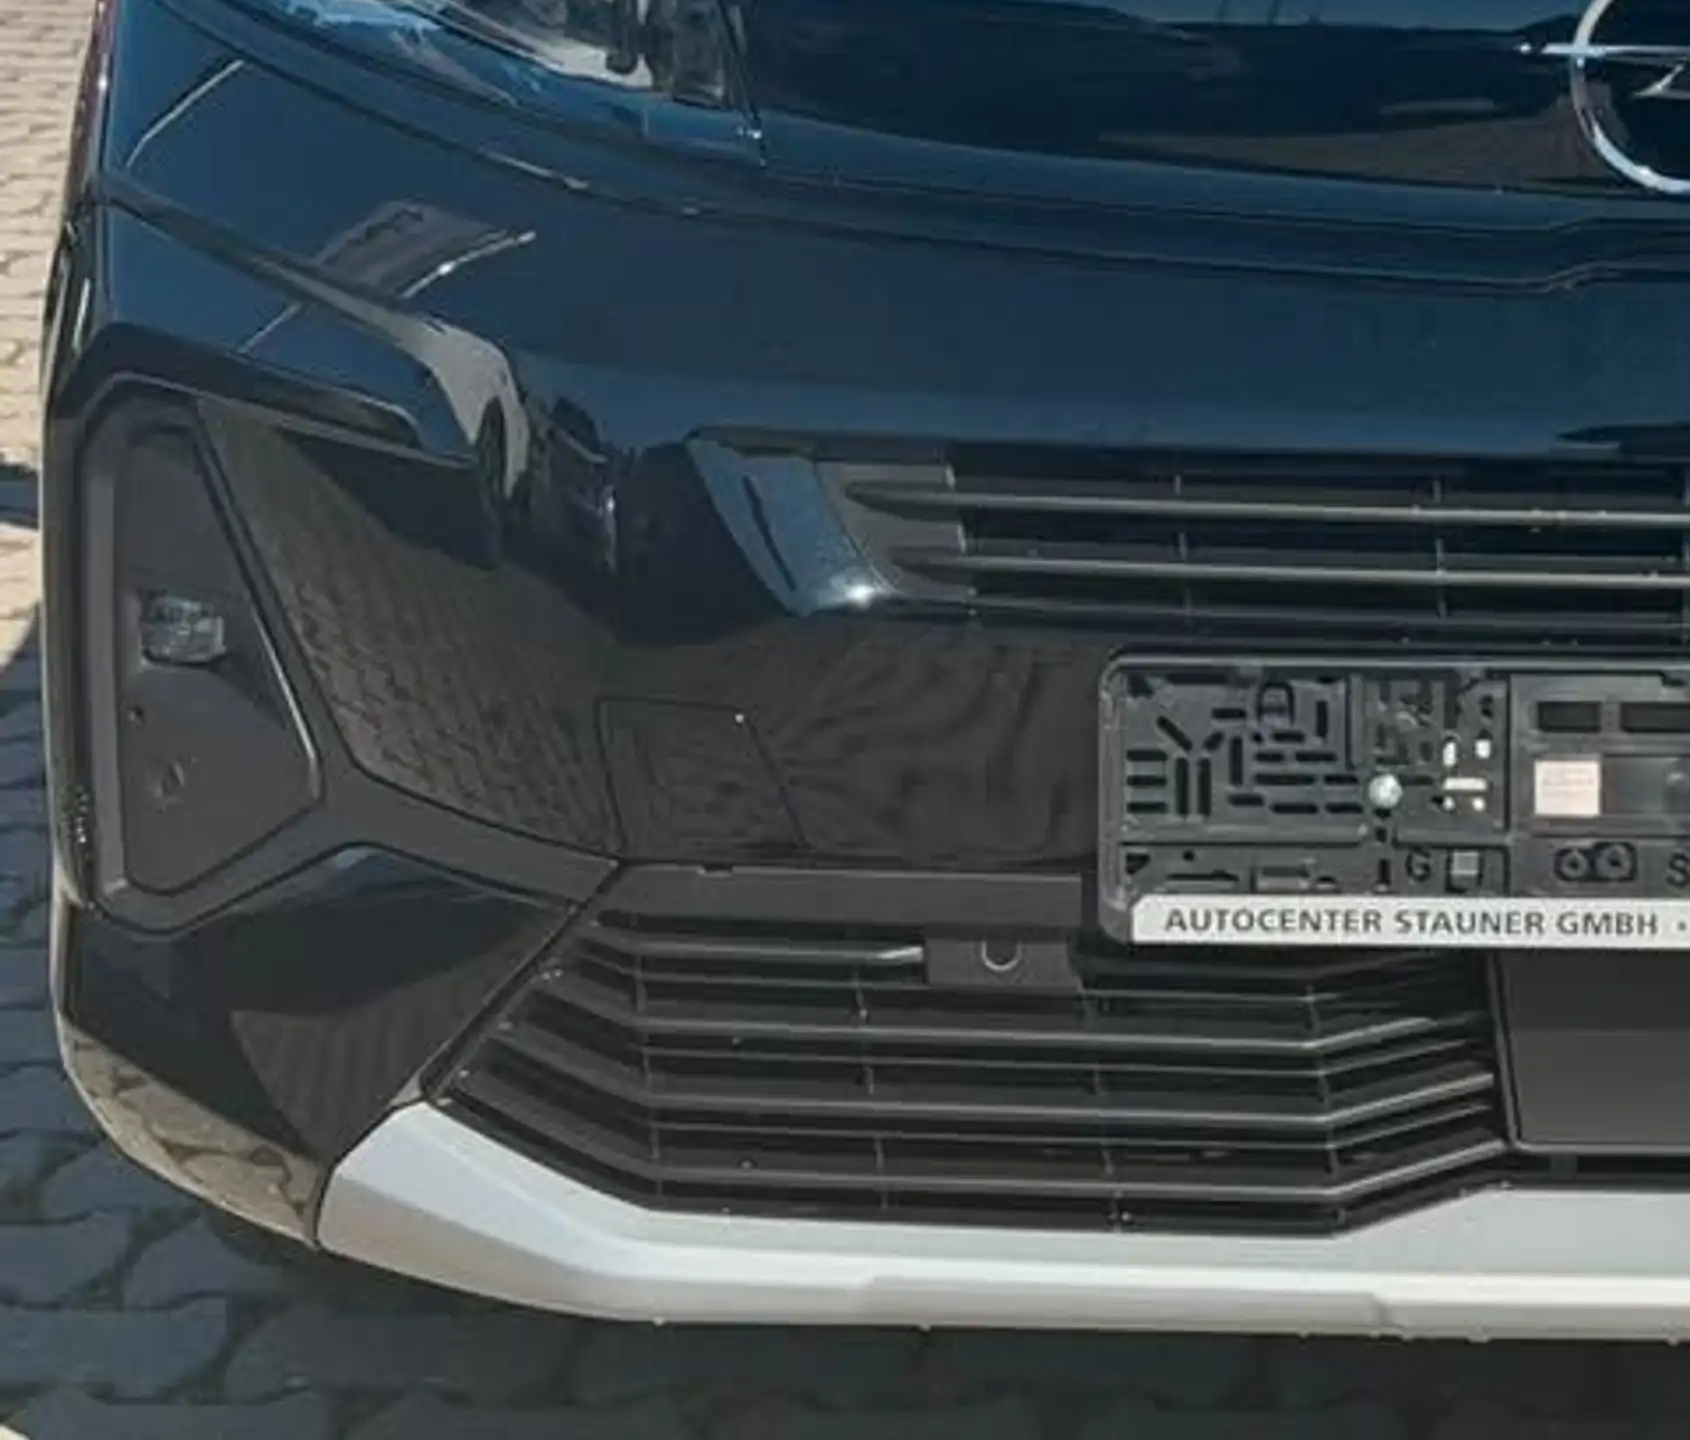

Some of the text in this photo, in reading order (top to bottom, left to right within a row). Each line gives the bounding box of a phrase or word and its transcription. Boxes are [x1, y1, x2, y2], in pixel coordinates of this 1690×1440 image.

[1165, 907, 1382, 933] AUTOCENTER
[1394, 909, 1544, 935] STAUNER
[1556, 911, 1659, 936] GMBH
